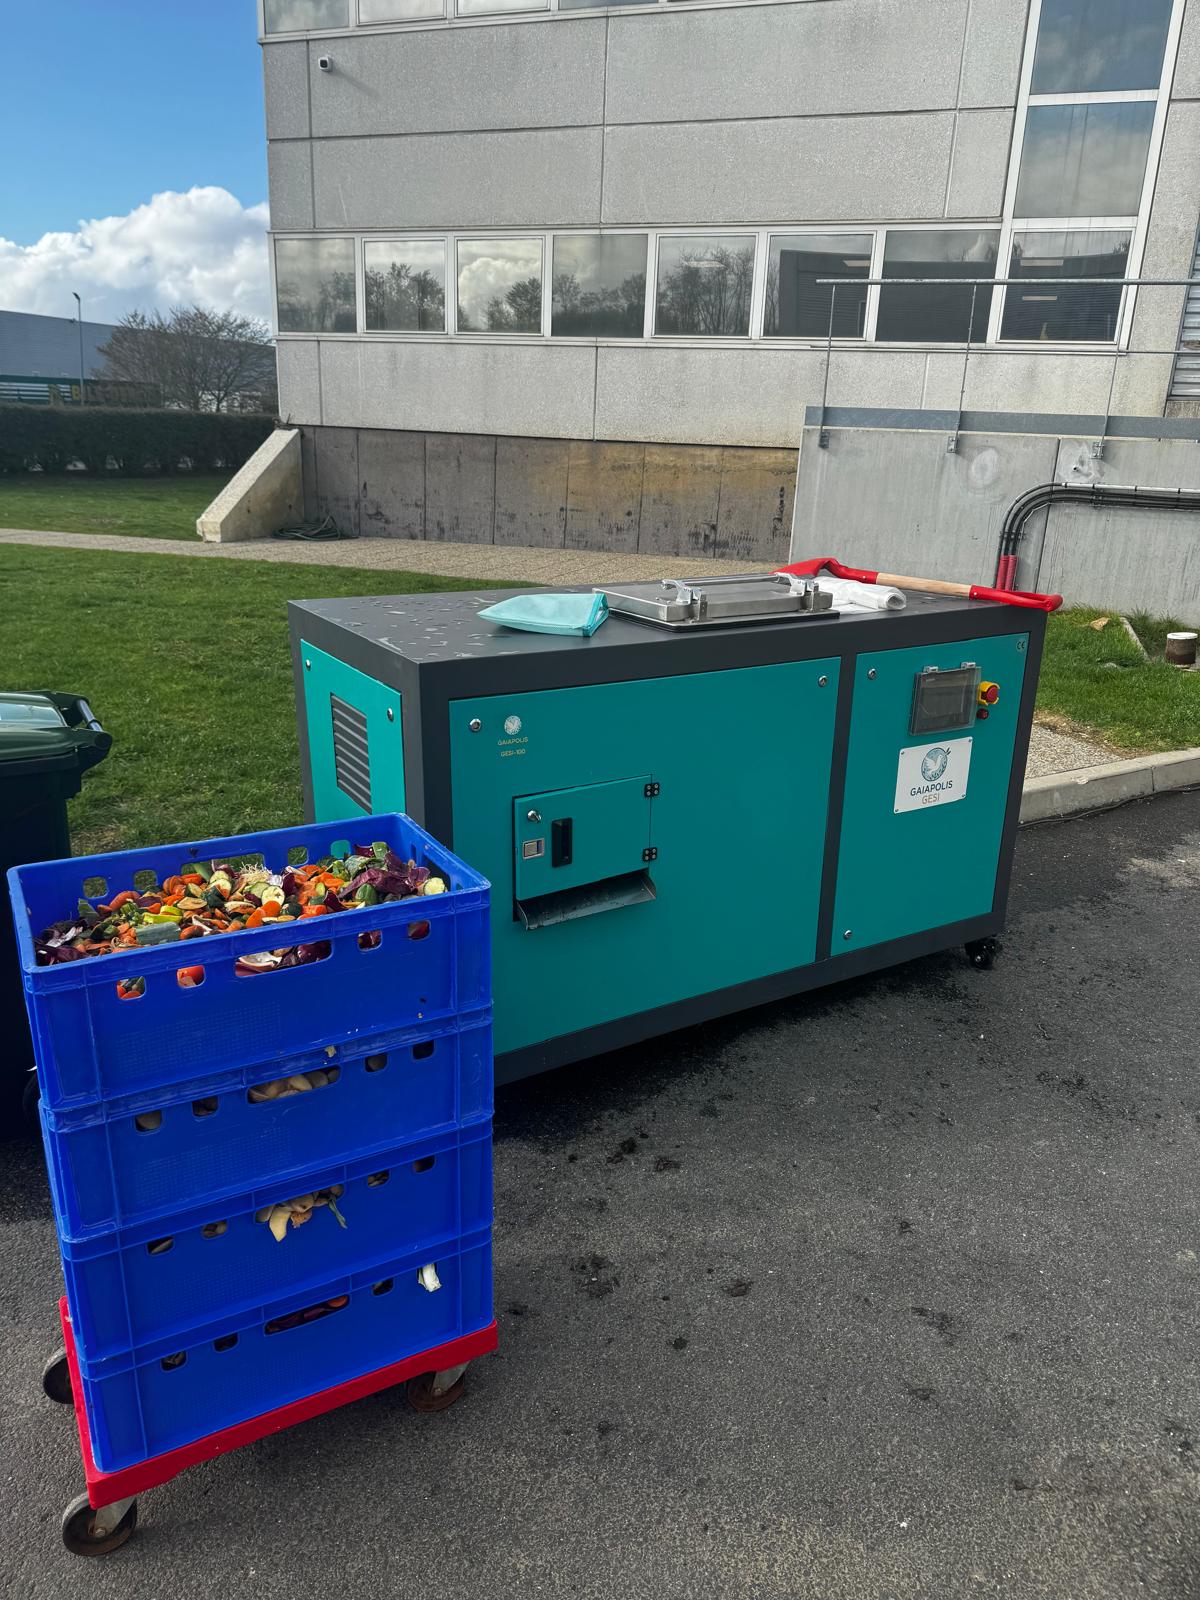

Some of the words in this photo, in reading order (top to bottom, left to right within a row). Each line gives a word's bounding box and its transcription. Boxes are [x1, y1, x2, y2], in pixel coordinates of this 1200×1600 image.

[497, 736, 528, 746] GAIAPOLIS
[500, 748, 526, 757] GESI-100
[910, 780, 953, 797] GAIAPOLIS
[922, 793, 940, 805] GESI
